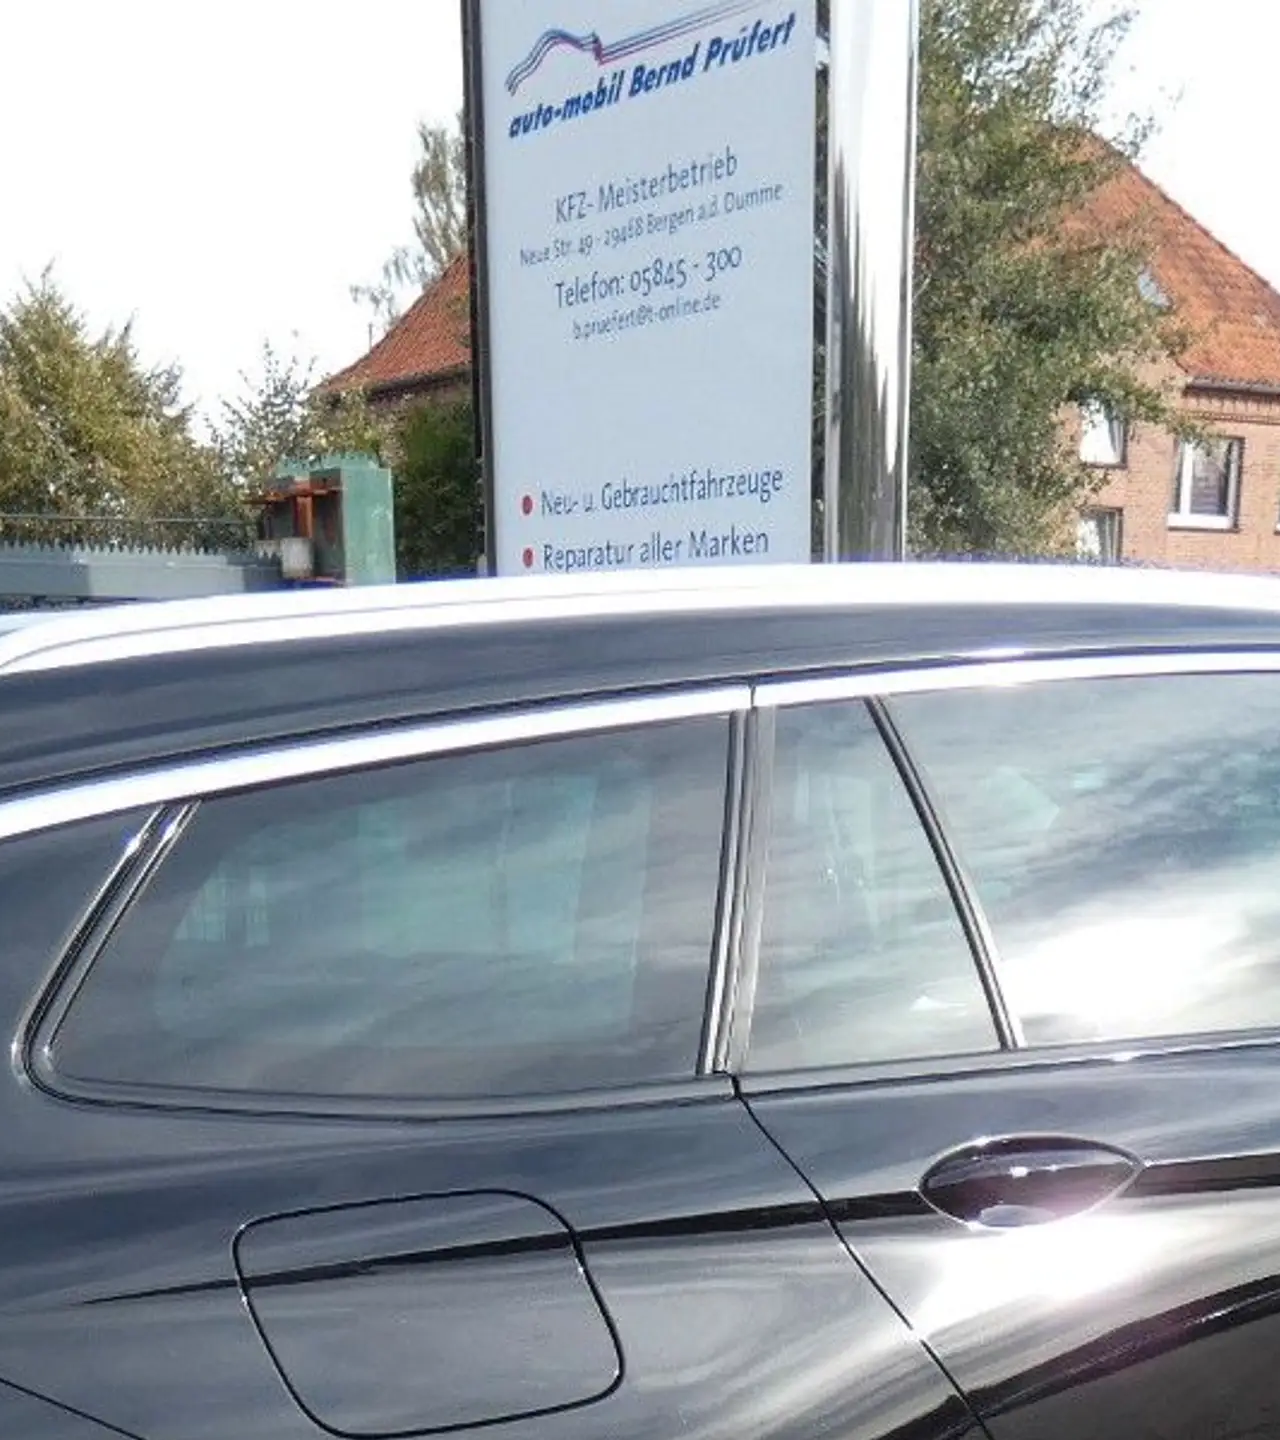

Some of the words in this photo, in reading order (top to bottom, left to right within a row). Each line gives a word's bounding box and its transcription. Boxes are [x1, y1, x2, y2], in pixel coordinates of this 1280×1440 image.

[509, 69, 625, 139] auto-mobil
[628, 41, 701, 97] Bernd
[702, 12, 796, 72] Prüfert
[555, 144, 738, 223] KFZ-Meisterbetrieb
[555, 270, 625, 308] Telefon:
[704, 245, 742, 282] 300
[600, 468, 783, 510] Gebrauchtfahrzeuge
[543, 541, 634, 575] Reparatur
[639, 530, 682, 564] aller
[687, 524, 770, 559] Marken
